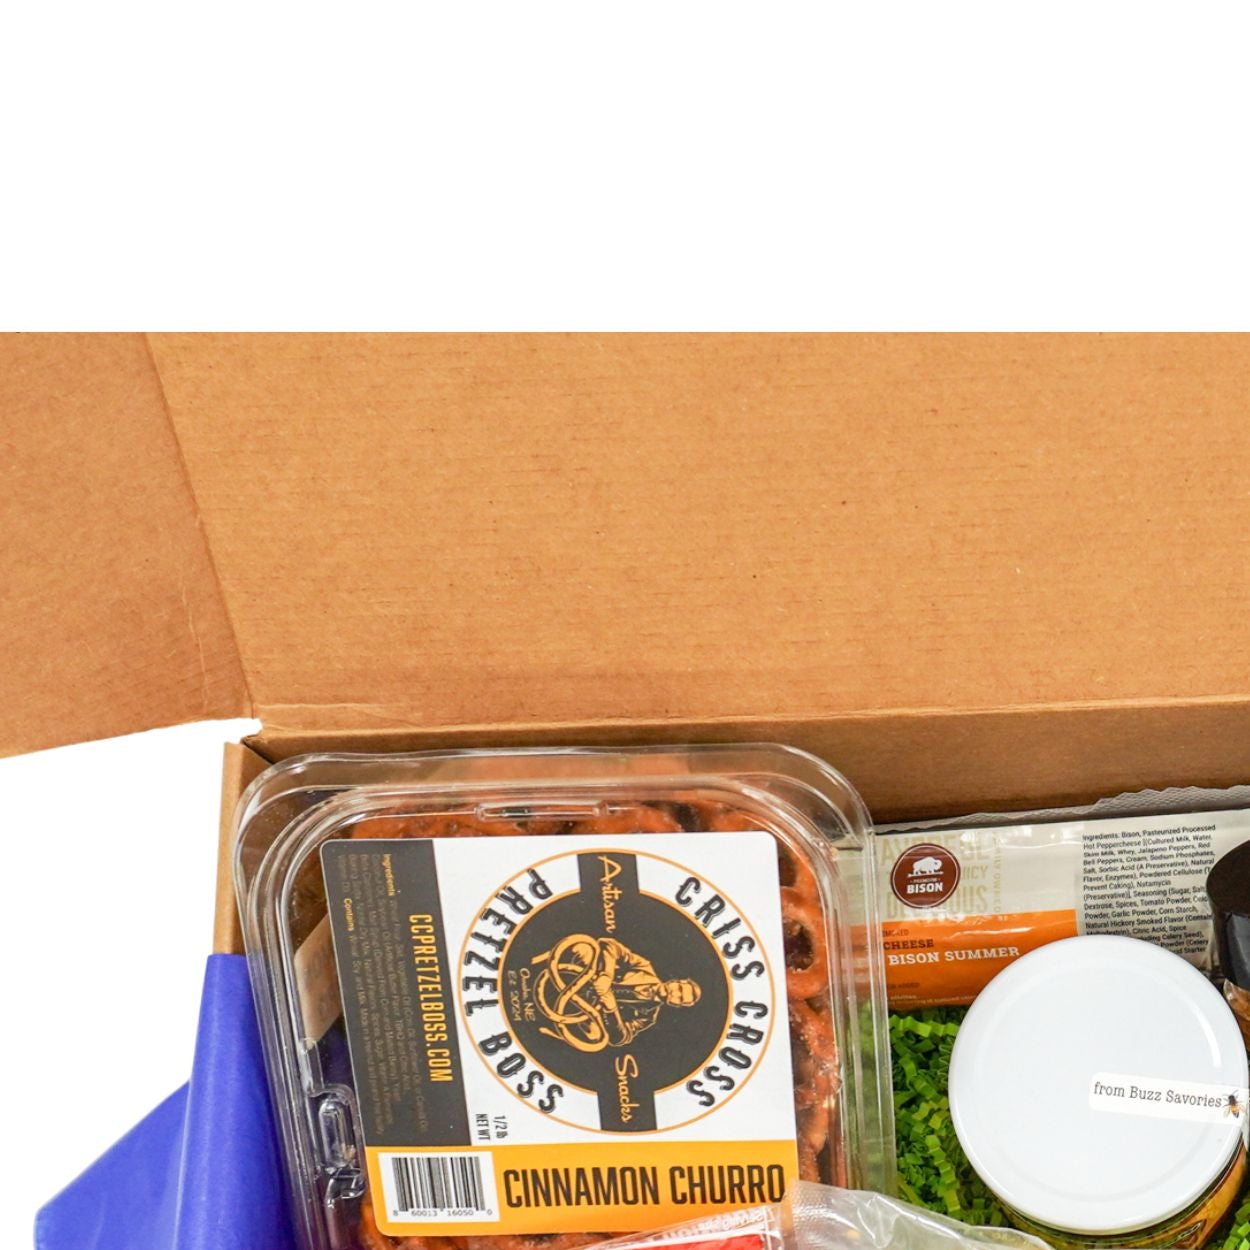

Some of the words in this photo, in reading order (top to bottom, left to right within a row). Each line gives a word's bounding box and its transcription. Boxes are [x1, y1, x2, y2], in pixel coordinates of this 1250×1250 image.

[1182, 824, 1216, 833] Processed
[1139, 870, 1172, 878] Powdered
[597, 855, 621, 933] Artisan
[907, 882, 943, 894] BISON
[674, 876, 765, 981] CRISS
[462, 868, 553, 1017] PRETZEL
[883, 939, 934, 950] CHEESE
[888, 953, 940, 966] BISON
[945, 946, 1020, 961] SUMMER
[409, 913, 453, 1083] CCPRETZELBOSS.COM
[686, 999, 768, 1107] CROSS
[478, 1031, 564, 1114] BOSS
[614, 1054, 638, 1122] Snacks
[1094, 1081, 1125, 1097] from
[1130, 1086, 1162, 1101] Buzz
[1165, 1090, 1222, 1108] Savories
[476, 1114, 489, 1126] NET
[478, 1129, 490, 1139] WT
[504, 1166, 660, 1208] CINNAMON
[669, 1164, 785, 1205] CHURRO
[487, 1208, 493, 1216] 0
